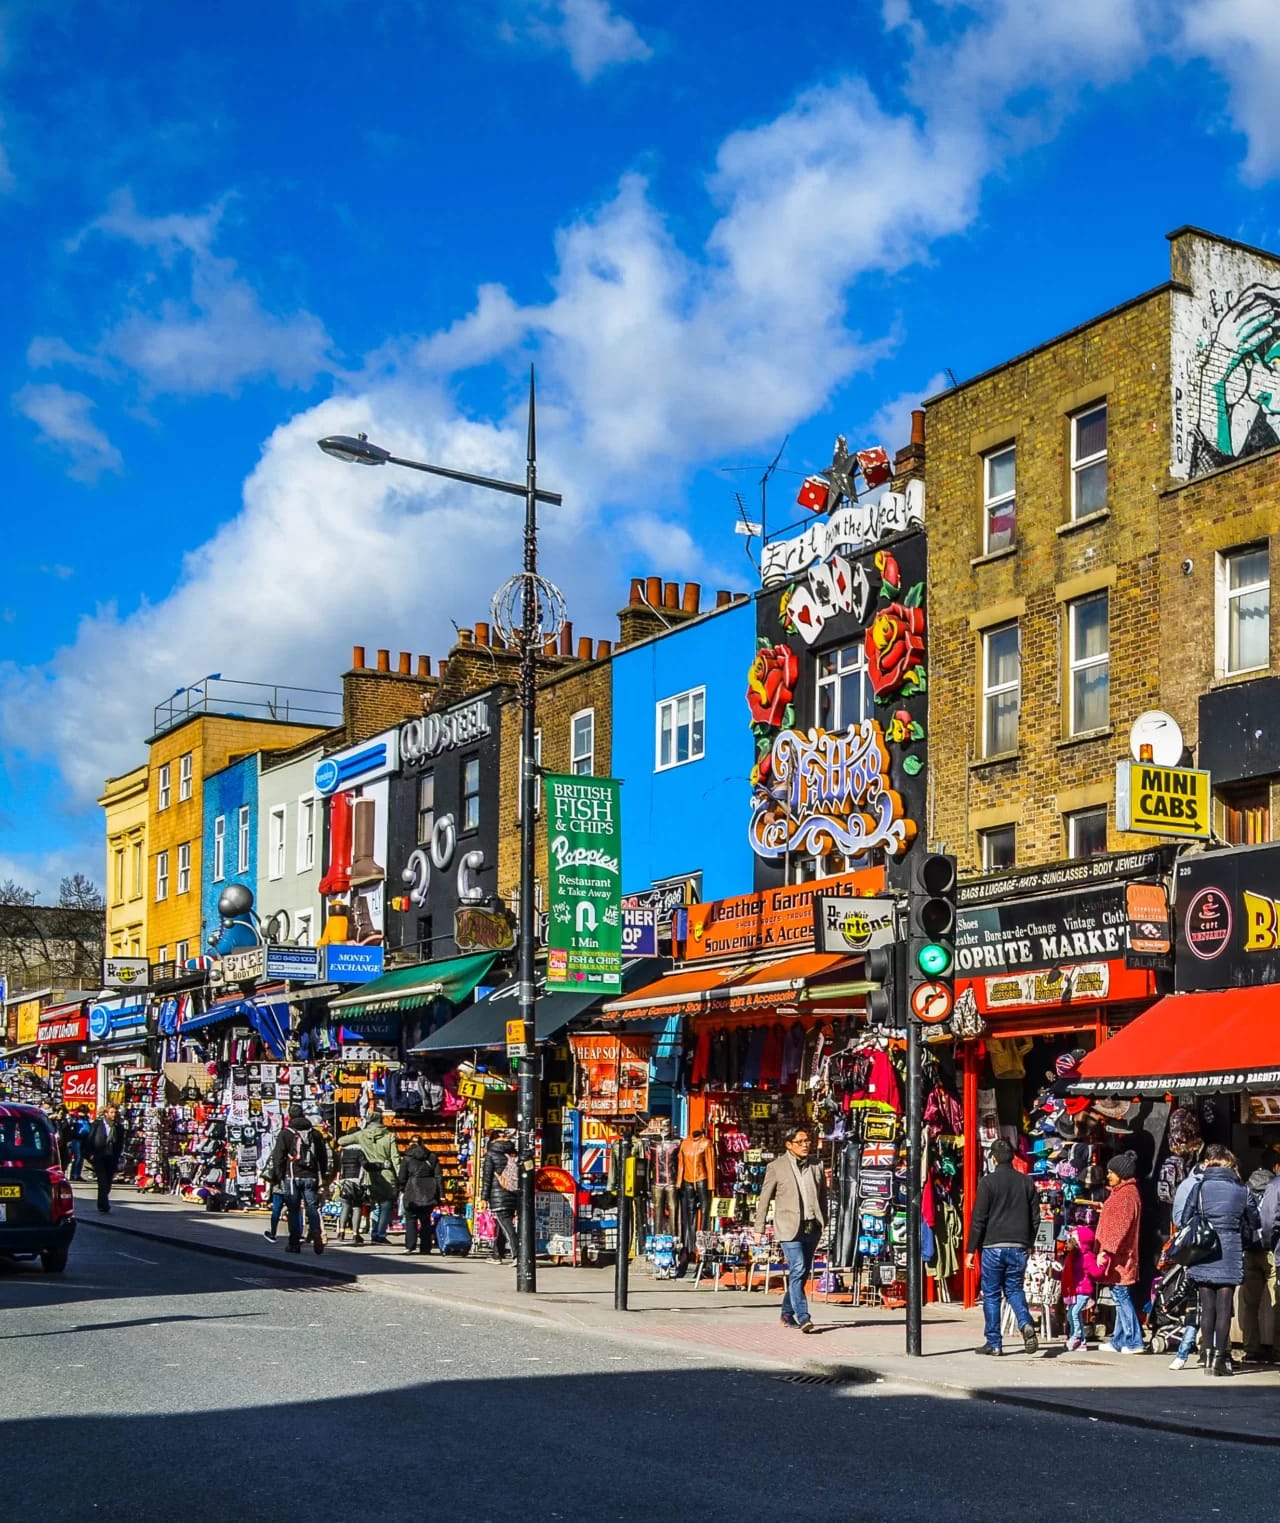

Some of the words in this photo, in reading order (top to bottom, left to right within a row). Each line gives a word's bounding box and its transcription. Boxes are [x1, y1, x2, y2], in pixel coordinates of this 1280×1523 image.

[844, 514, 861, 537] the
[1141, 769, 1197, 796] MINI
[553, 783, 613, 801] BRITISH
[554, 796, 613, 822] FISH
[1139, 794, 1198, 820] CABS
[555, 818, 567, 831] &
[569, 819, 614, 835] CHIPS
[551, 834, 619, 872] Poppies
[558, 874, 612, 888] Restaurant
[961, 888, 978, 900] BAGS
[985, 880, 1016, 896] LUGGAGE
[1019, 877, 1037, 888] HATS
[1042, 868, 1088, 885] SUNGLASSES
[1093, 862, 1112, 875] BODY
[558, 887, 566, 895] &
[567, 887, 587, 897] Take
[588, 889, 612, 900] Away
[621, 910, 653, 926] HER
[710, 900, 766, 923] Leather
[827, 905, 841, 918] Dr
[827, 913, 893, 934] Martens
[955, 933, 979, 946] eather
[984, 922, 1057, 942] Bureau-de-Change
[1063, 915, 1096, 932] Vintage
[958, 919, 979, 930] Shoes
[571, 937, 576, 947] 1
[578, 937, 599, 948] Min
[705, 932, 763, 953] Souvenirs
[764, 927, 774, 939] &
[1042, 925, 1131, 961] MARKET
[338, 953, 371, 962] MONEY
[549, 961, 567, 969] Chip
[569, 955, 587, 964] FISH
[596, 957, 620, 966] CHIPS
[107, 967, 147, 977] Martens
[233, 971, 250, 979] BODY
[330, 963, 381, 973] EXCHANGE
[649, 1005, 681, 1016] Garments
[753, 991, 797, 1004] Accessories
[65, 1063, 95, 1071] Clearance
[65, 1075, 96, 1095] Sale
[461, 1083, 477, 1096] £1
[1105, 1081, 1125, 1090] PIZZA
[1135, 1080, 1157, 1089] FRESH
[1159, 1079, 1176, 1088] FAST
[1177, 1078, 1195, 1087] FOOD
[1197, 1077, 1208, 1086] ON
[1209, 1076, 1224, 1085] THE
[1223, 1075, 1235, 1084] GO
[65, 1101, 79, 1110] UP
